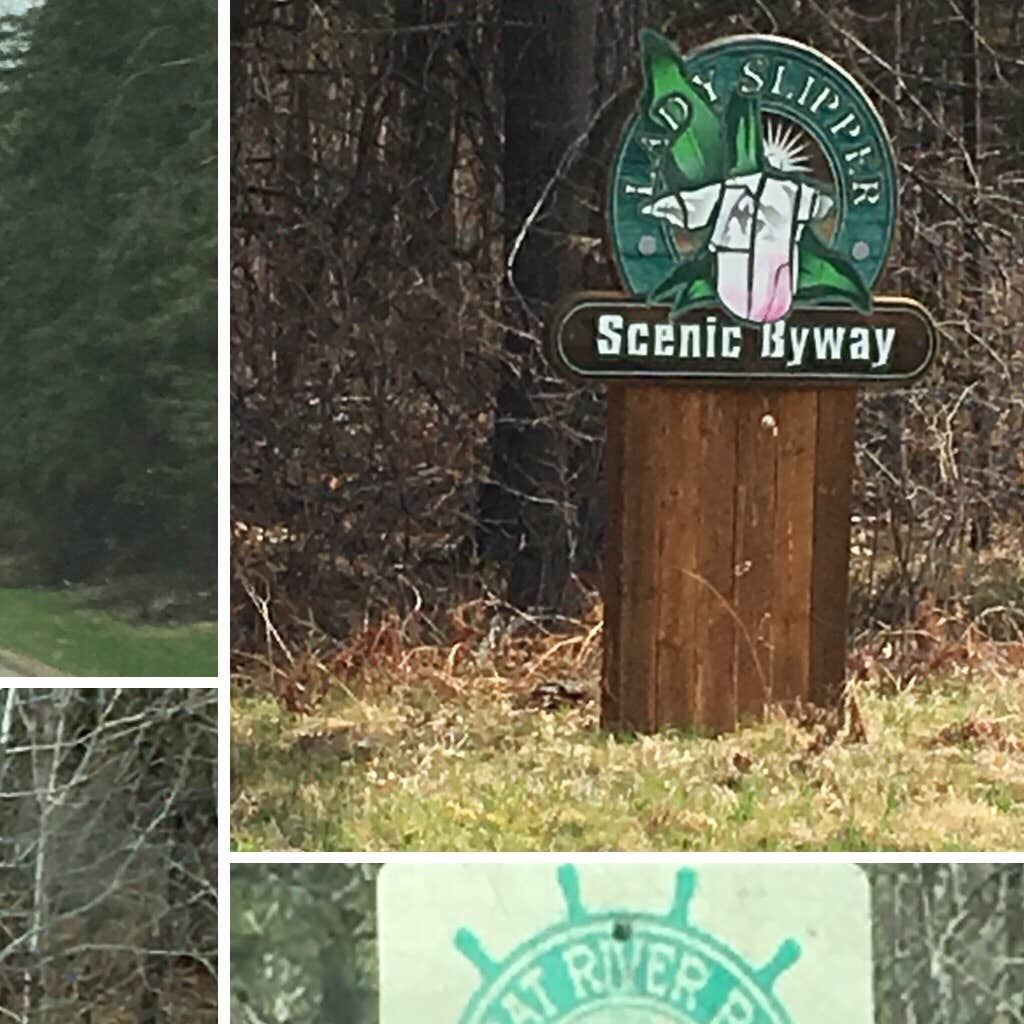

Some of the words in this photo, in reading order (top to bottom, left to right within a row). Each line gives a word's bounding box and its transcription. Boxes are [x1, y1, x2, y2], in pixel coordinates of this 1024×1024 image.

[740, 63, 881, 206] SLIPPER
[597, 314, 742, 358] Scenic
[761, 318, 896, 367] Byway
[563, 937, 709, 1011] RIVER
